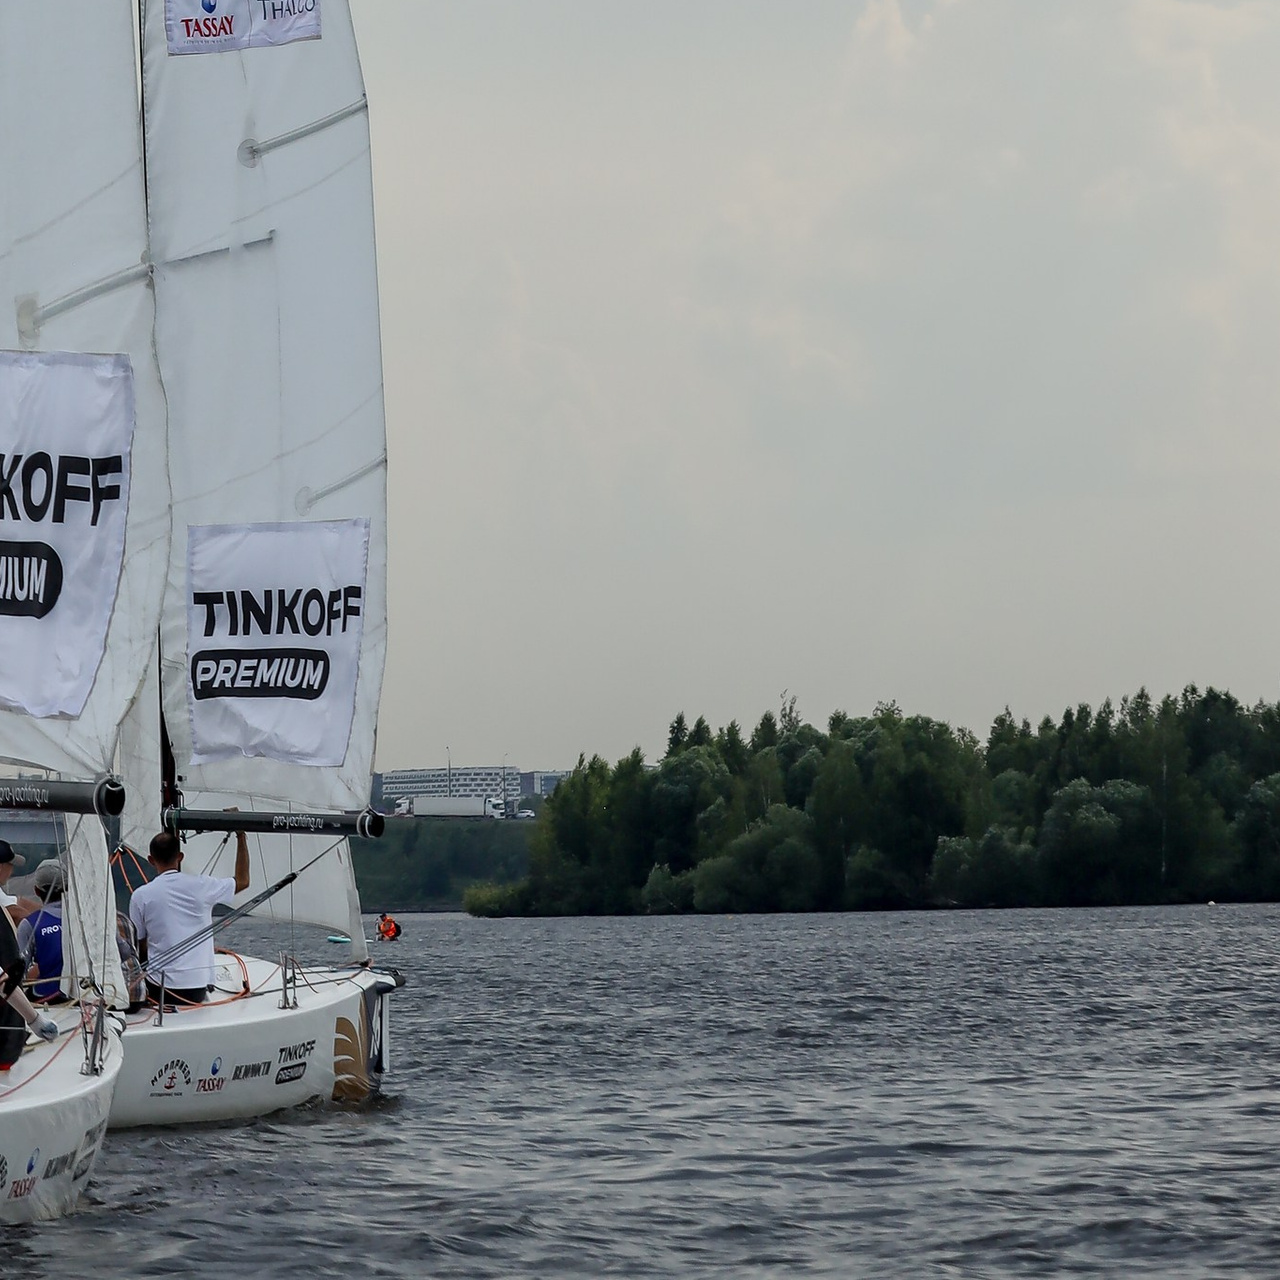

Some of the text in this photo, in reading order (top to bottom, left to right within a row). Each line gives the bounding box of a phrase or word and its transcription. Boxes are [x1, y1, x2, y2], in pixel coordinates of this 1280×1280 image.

[180, 15, 235, 38] TASSAY
[193, 585, 362, 637] TINKOFF
[196, 657, 325, 690] PREMIUM
[272, 814, 325, 832] pro-yachting.ru
[277, 1039, 317, 1064] TINKOFF
[195, 1076, 225, 1093] TASSAY
